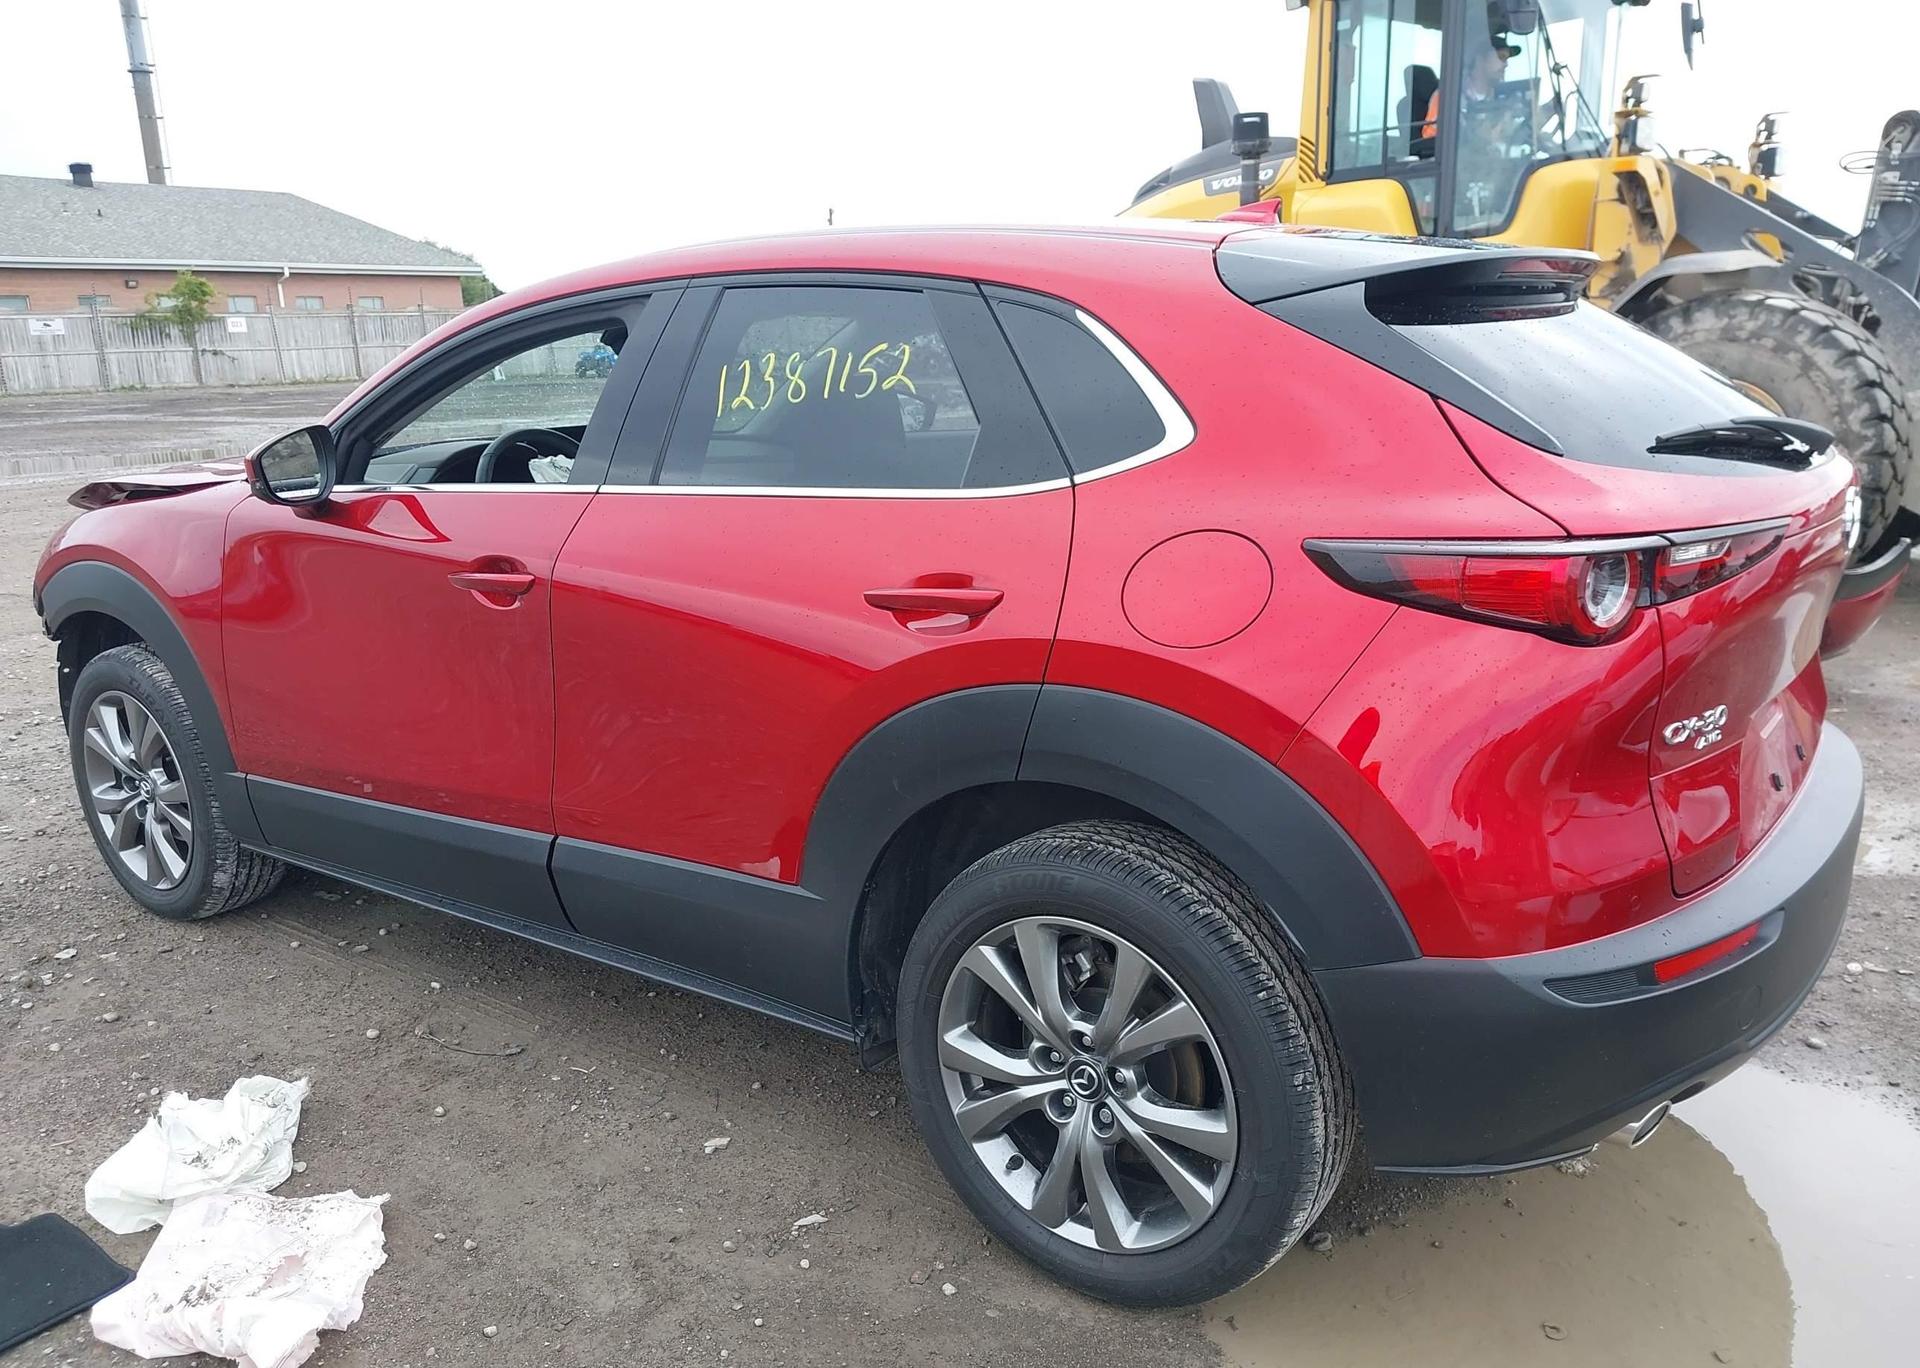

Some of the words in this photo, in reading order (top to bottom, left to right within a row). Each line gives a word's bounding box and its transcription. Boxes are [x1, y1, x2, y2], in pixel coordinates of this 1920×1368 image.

[1211, 168, 1274, 190] VOLO
[717, 342, 916, 417] 12387152
[1662, 704, 1728, 745] CX-30
